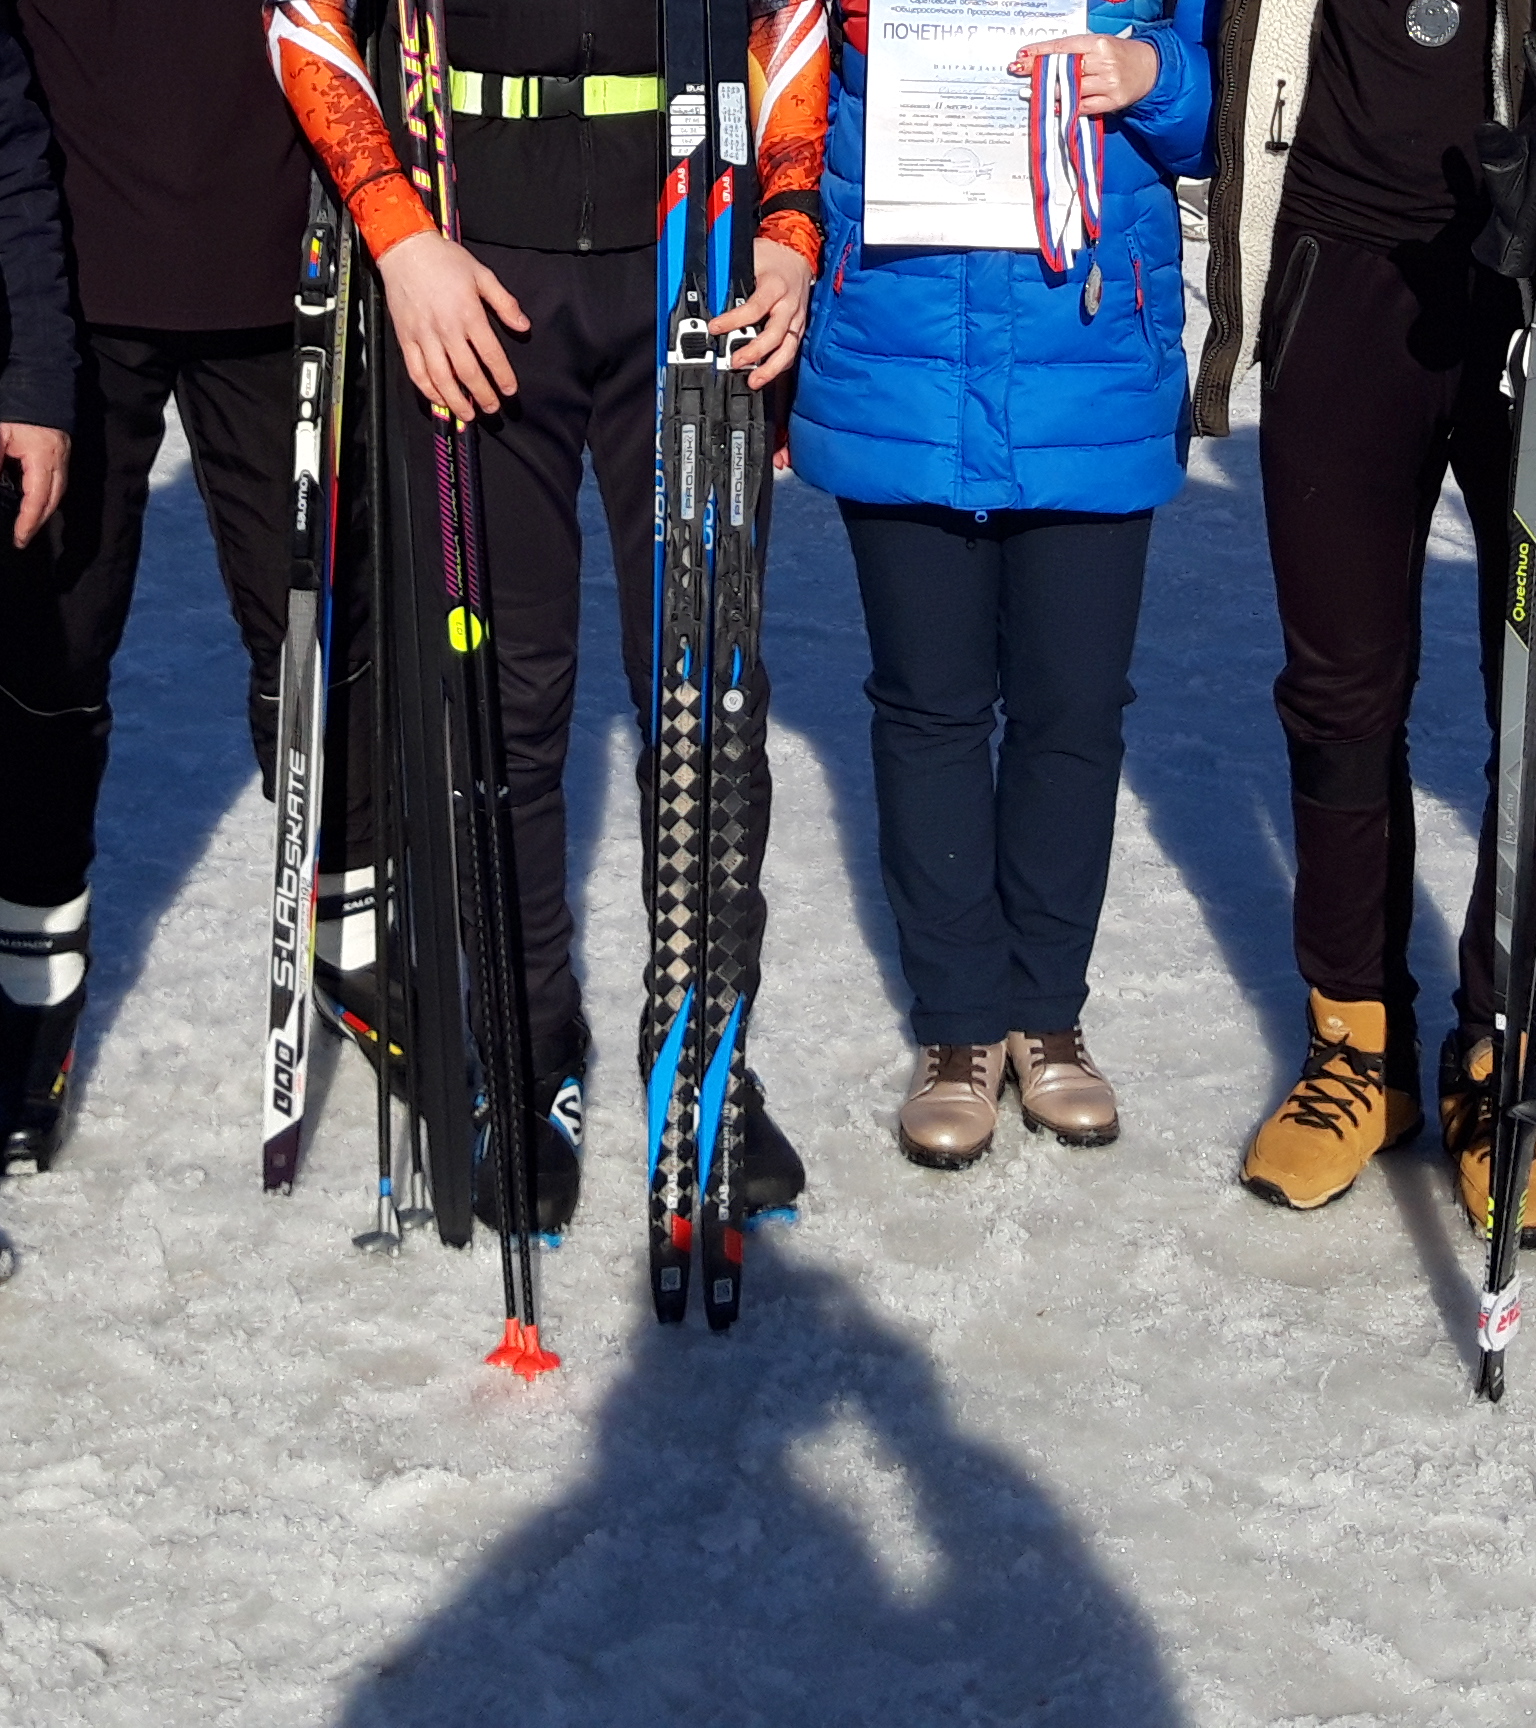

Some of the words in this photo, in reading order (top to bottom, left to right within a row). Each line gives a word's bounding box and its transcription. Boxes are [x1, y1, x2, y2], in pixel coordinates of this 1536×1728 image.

[883, 23, 978, 41] ПОЧЕТНАЯ
[1511, 542, 1531, 623] Quechua
[282, 748, 307, 868] SKATE
[272, 1039, 294, 1117] LAB
